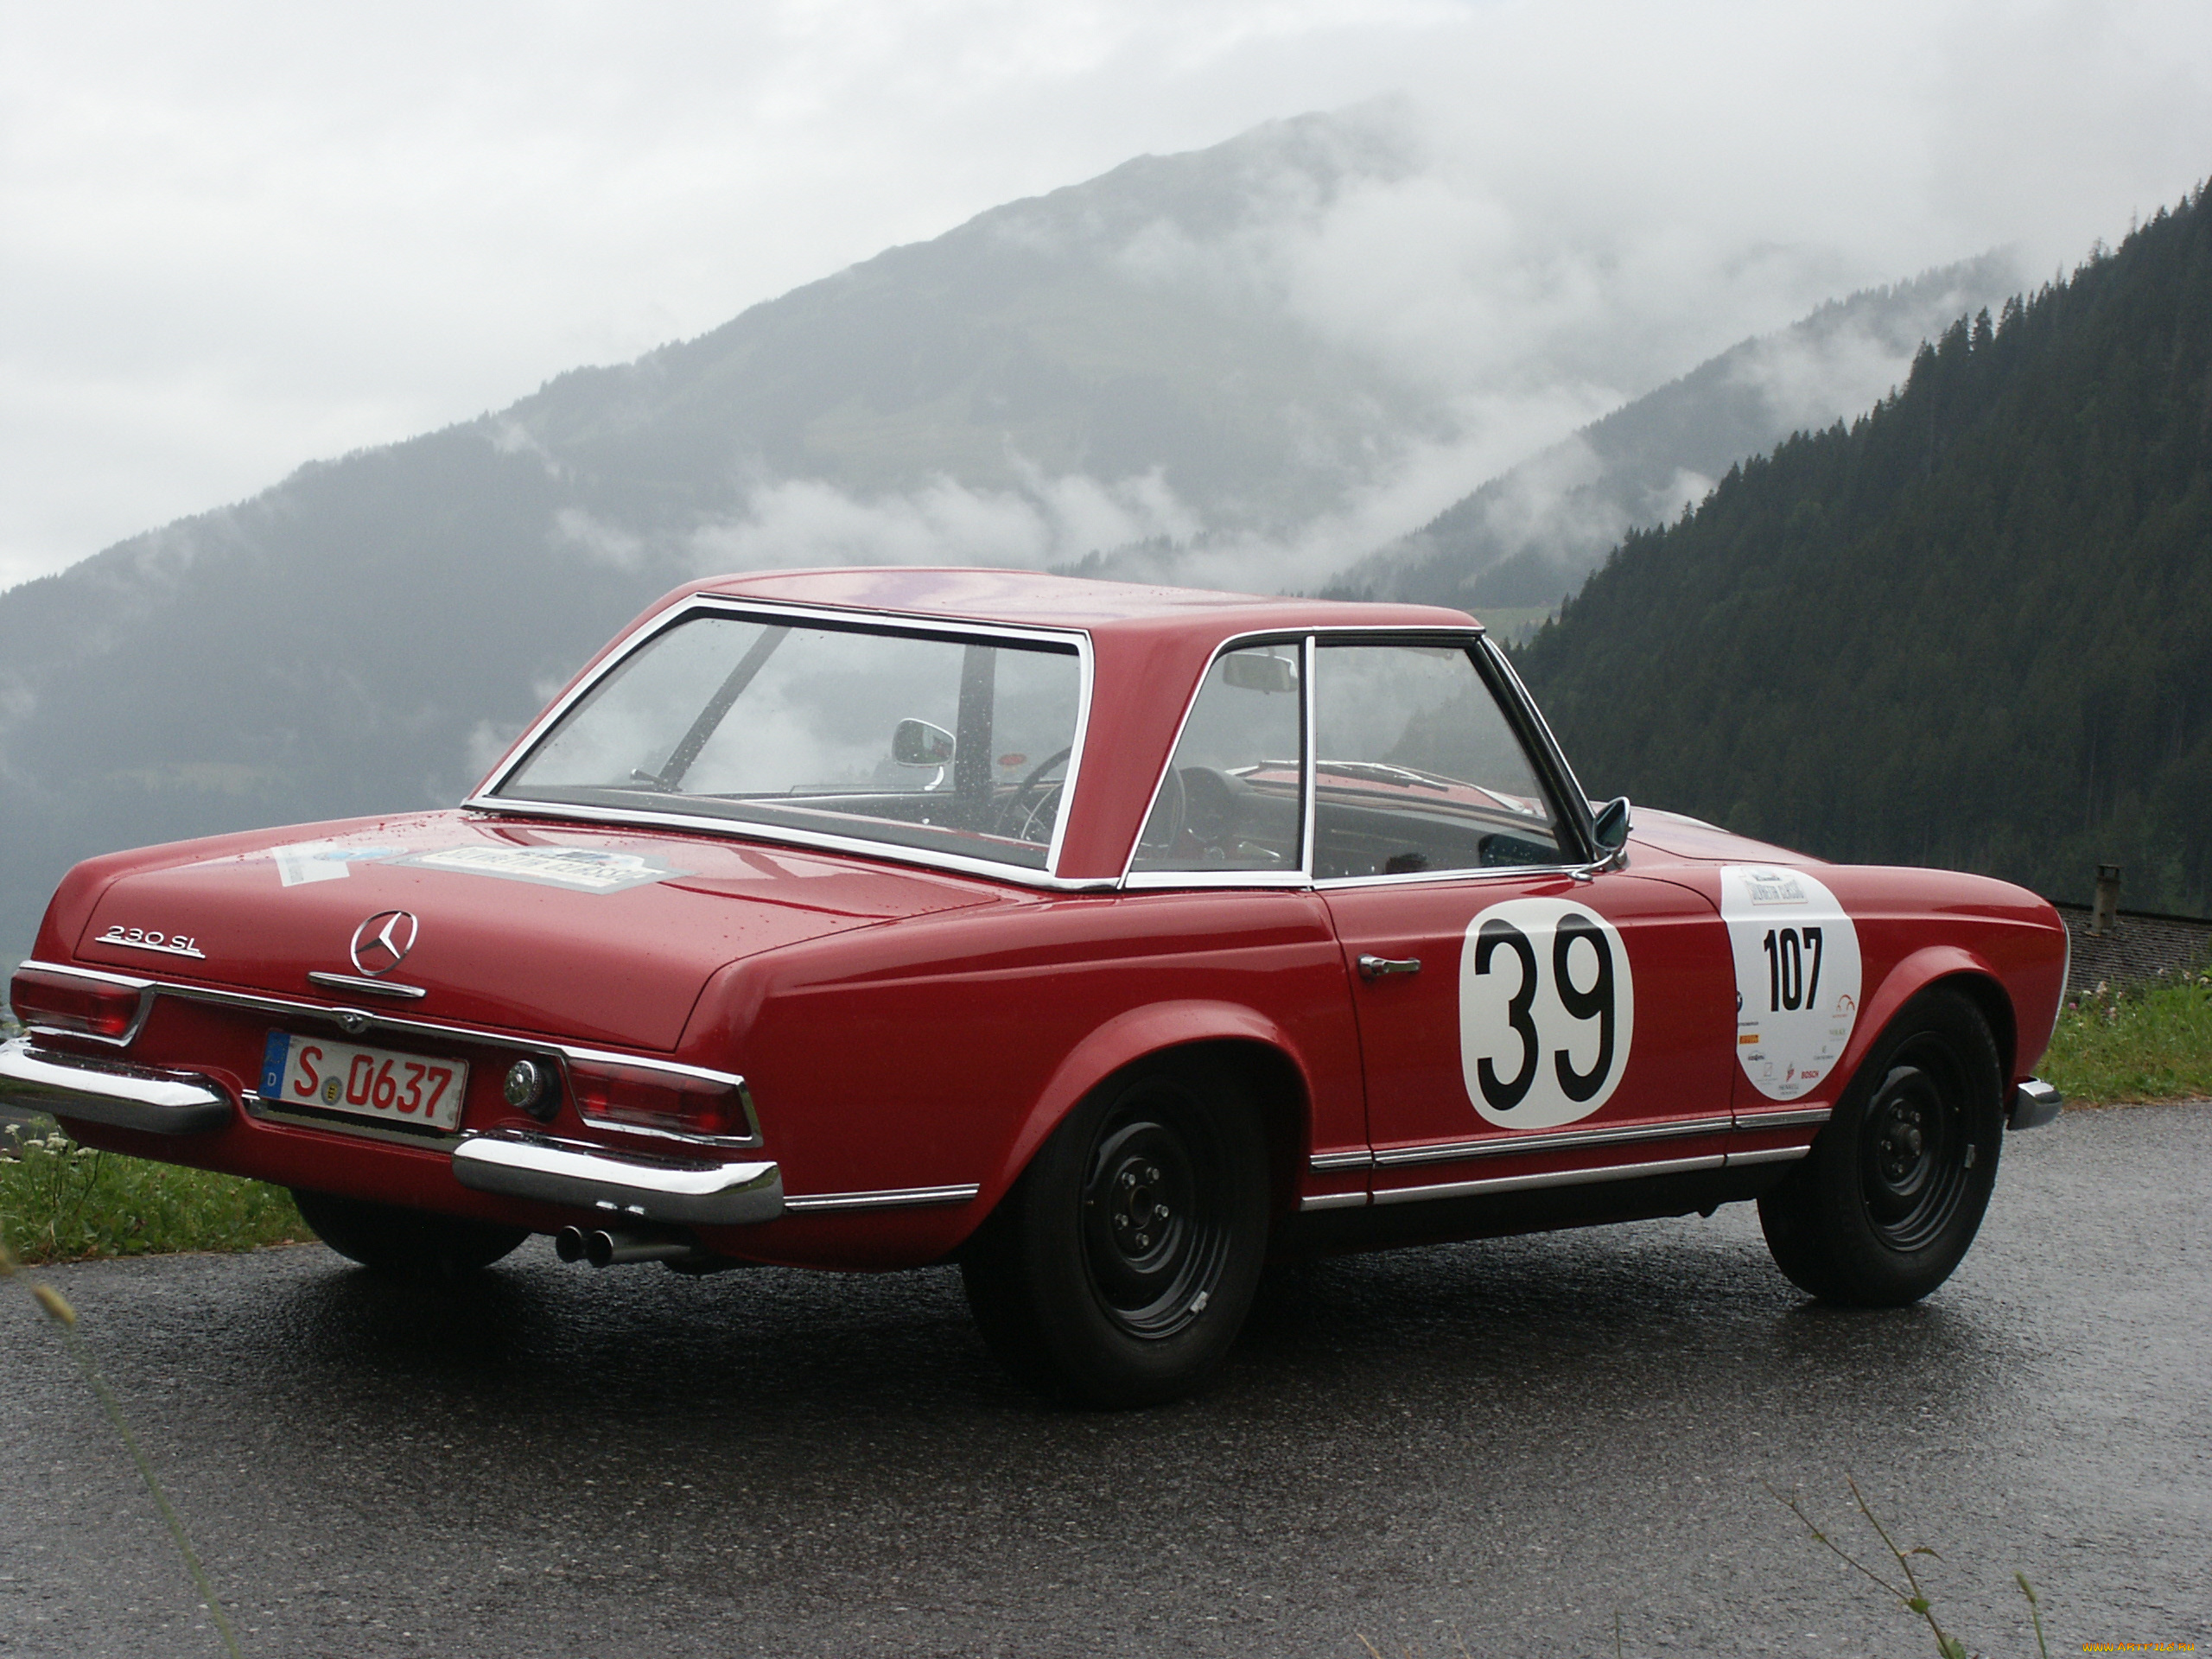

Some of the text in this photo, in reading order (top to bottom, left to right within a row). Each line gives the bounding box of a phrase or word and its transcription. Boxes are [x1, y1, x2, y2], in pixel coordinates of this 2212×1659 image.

[105, 925, 200, 952] 230 SL
[1764, 927, 1822, 1012] 107
[1475, 912, 1614, 1111] 39
[267, 1072, 276, 1087] D
[294, 1046, 453, 1118] S 0637
[1802, 1071, 1819, 1079] BOSCH
